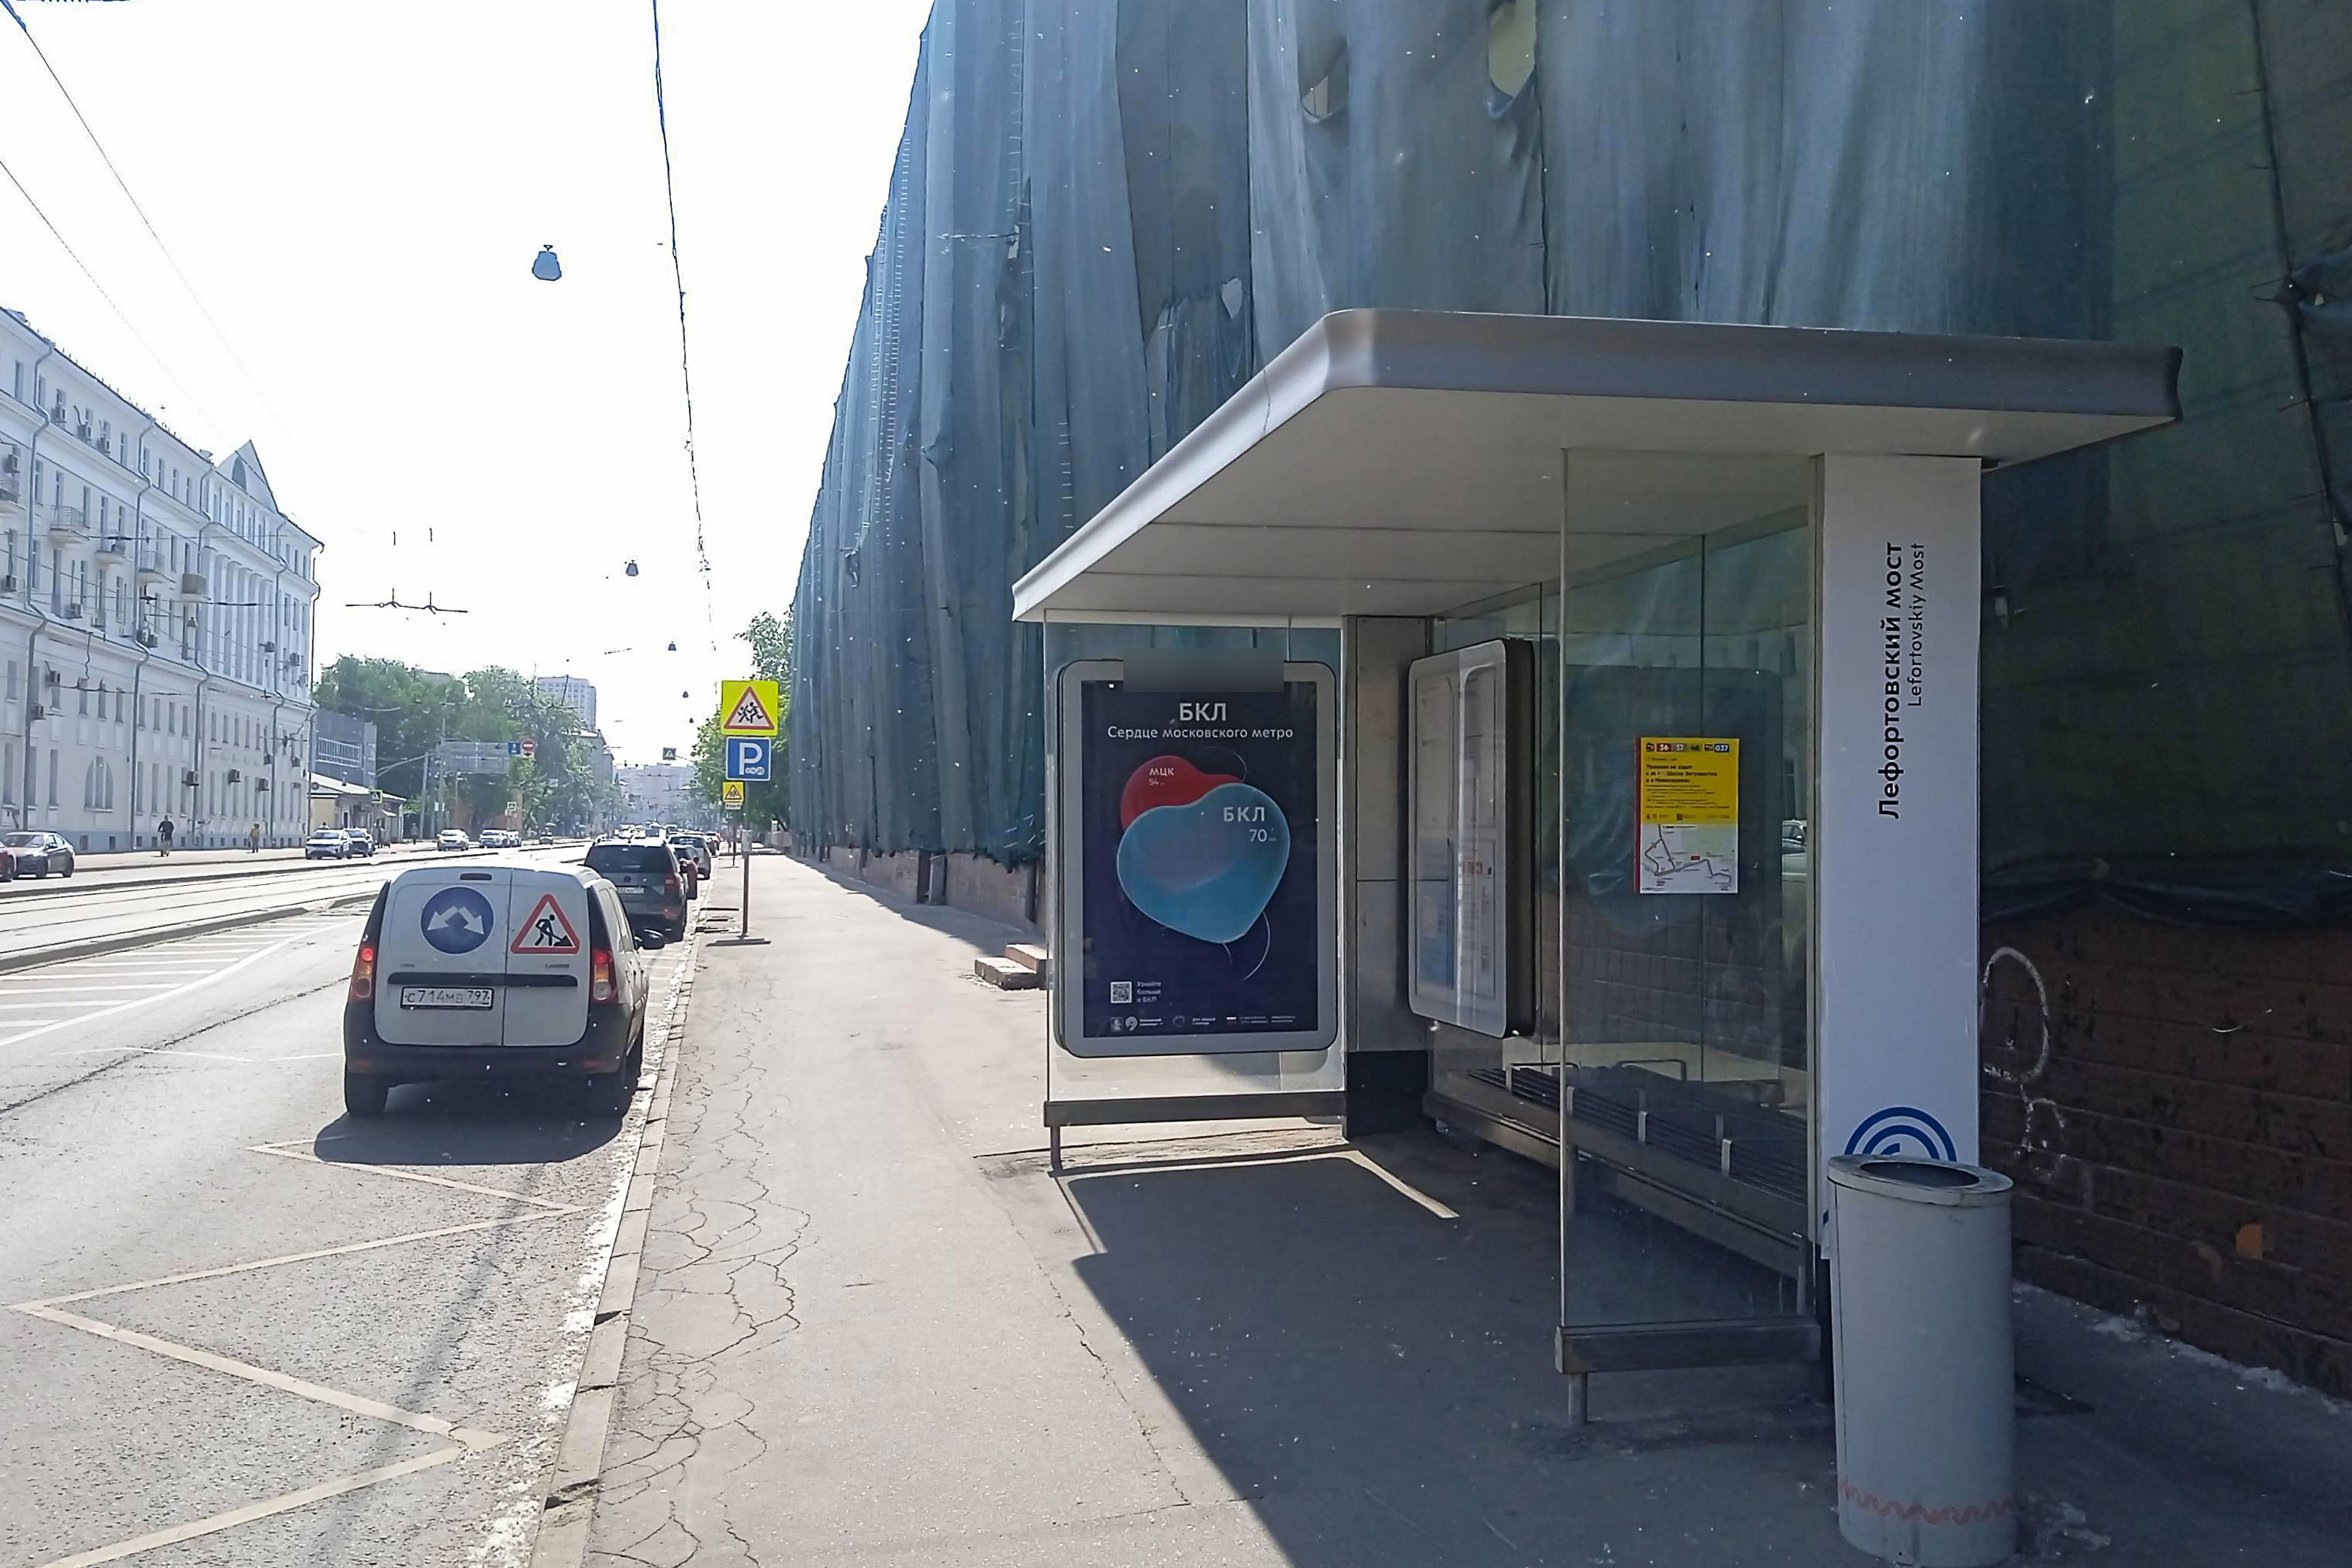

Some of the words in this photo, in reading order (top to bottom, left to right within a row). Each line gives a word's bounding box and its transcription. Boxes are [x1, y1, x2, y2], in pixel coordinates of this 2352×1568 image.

[1886, 542, 1903, 608] мост
[1909, 543, 1924, 590] Most
[1907, 597, 1926, 706] Lefortovskiy
[1179, 702, 1227, 721] БКЛ
[1877, 617, 1904, 819] Лефортовский
[1107, 726, 1158, 740] Сердце
[1162, 727, 1248, 738] московского
[1251, 727, 1294, 740] метро
[739, 742, 763, 775] P
[1148, 767, 1174, 777] МЦК
[1223, 806, 1265, 822] БКЛ
[1248, 828, 1267, 842] 70
